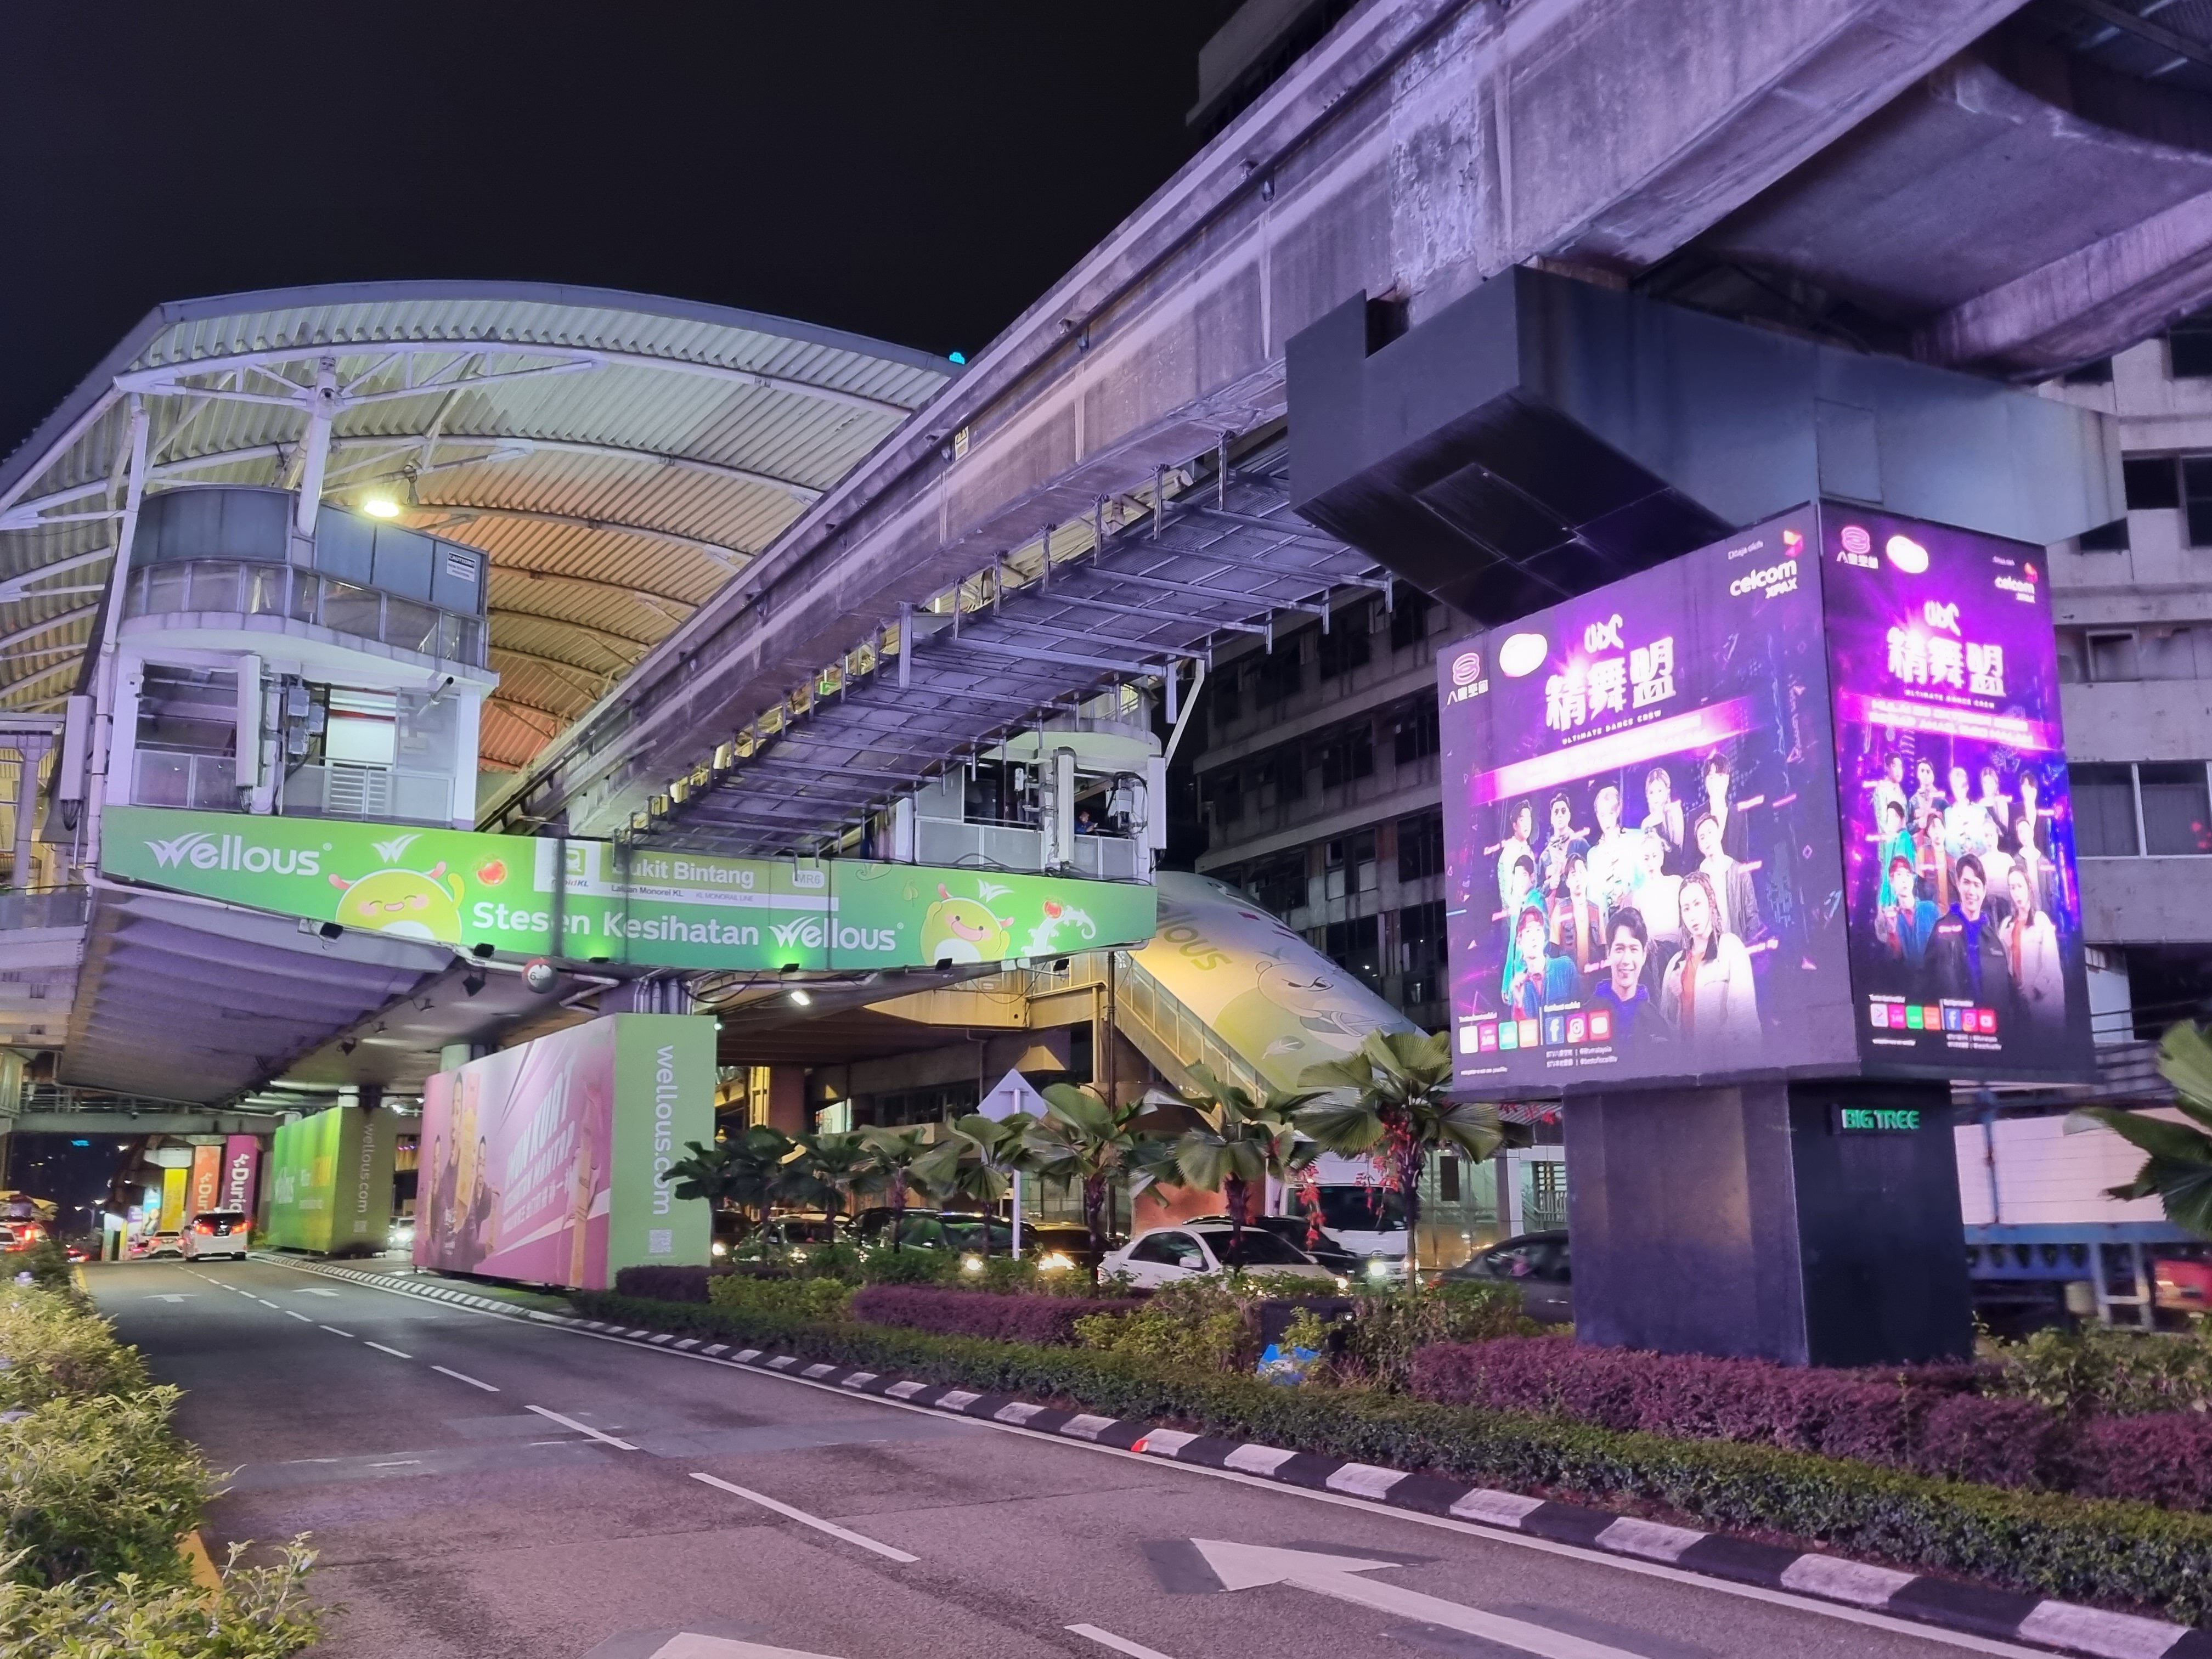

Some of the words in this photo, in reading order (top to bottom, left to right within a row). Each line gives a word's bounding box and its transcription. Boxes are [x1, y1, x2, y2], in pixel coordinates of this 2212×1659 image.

[1730, 560, 1797, 596] celcom
[1562, 727, 1602, 745] ULTIMATE
[1605, 718, 1633, 732] DANCE
[1637, 710, 1661, 723] CREW
[143, 832, 320, 876] Wellous
[640, 887, 671, 896] Monorel
[673, 889, 684, 897] KL
[674, 861, 754, 889] Bintang
[796, 873, 821, 884] MR6
[604, 911, 759, 945] Kesihatan
[768, 916, 896, 951] Wellous
[653, 1044, 679, 1216] wellous.com
[1842, 1109, 1874, 1128] BIG
[1874, 1110, 1920, 1129] TREE
[357, 1124, 376, 1213] wellous.com
